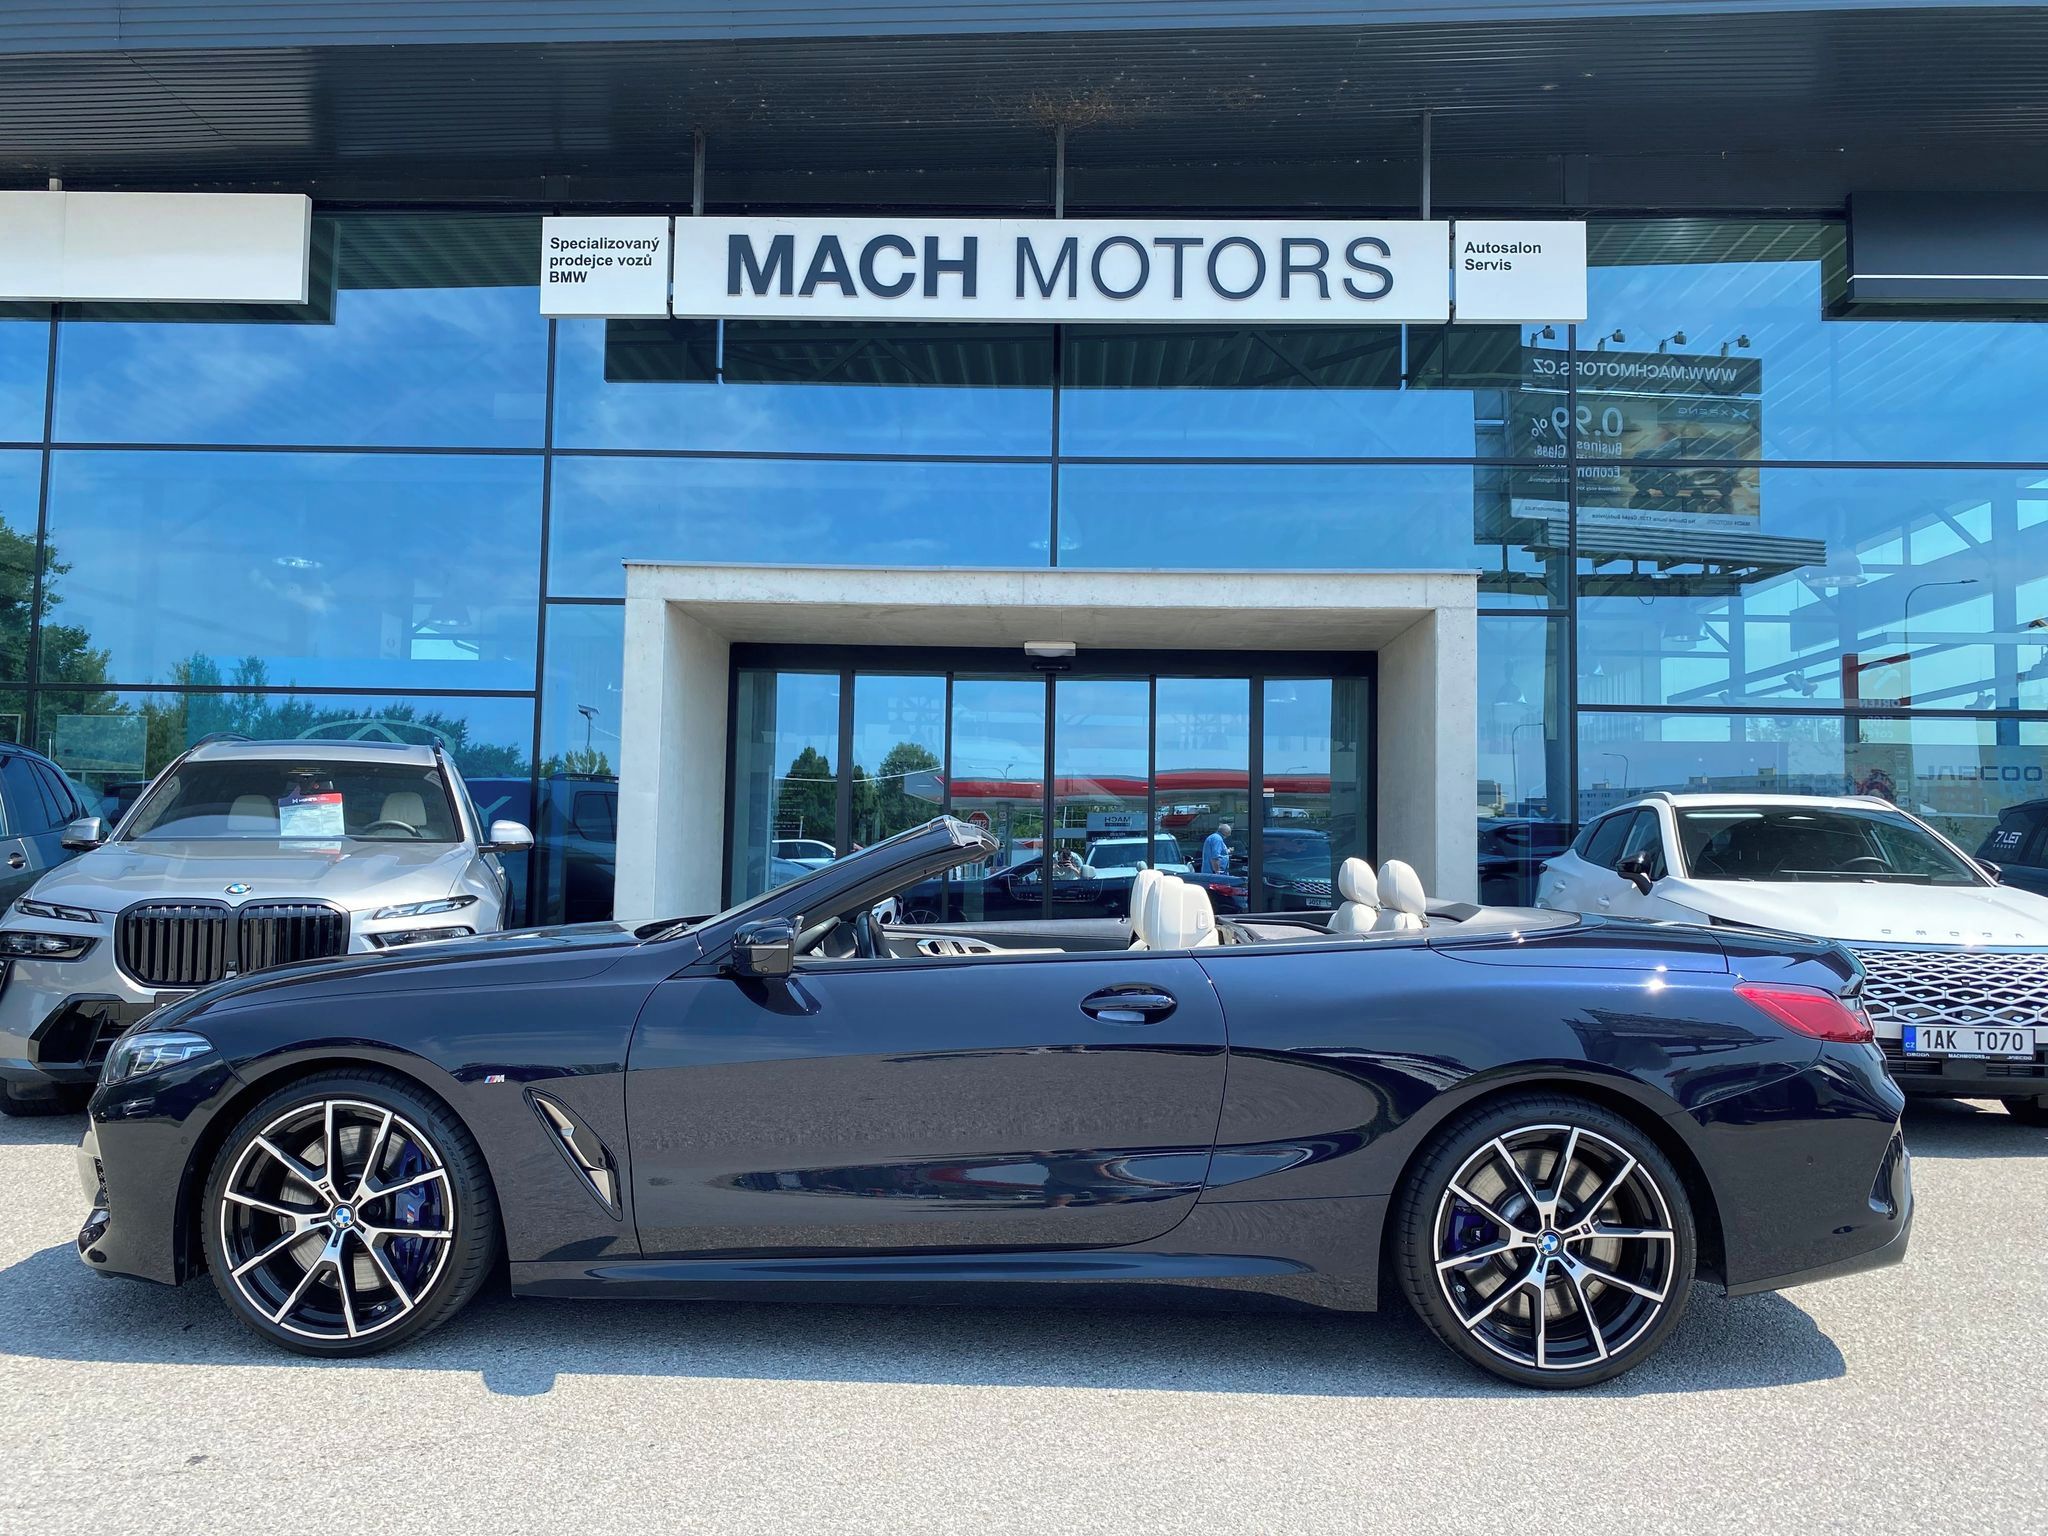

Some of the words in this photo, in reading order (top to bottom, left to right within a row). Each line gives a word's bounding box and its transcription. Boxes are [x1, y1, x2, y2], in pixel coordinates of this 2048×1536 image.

[550, 237, 660, 252] Specializovaný
[1464, 241, 1542, 254] Autosalon
[549, 254, 614, 269] prodejce
[617, 253, 652, 266] vozů
[727, 234, 977, 299] MACH
[1015, 235, 1394, 301] MOTORS
[1464, 258, 1512, 271] Servis
[549, 271, 588, 283] BMW
[1917, 766, 2043, 781] JAECOO
[1905, 1041, 1916, 1049] CZ
[1922, 1029, 1958, 1050] 1AK
